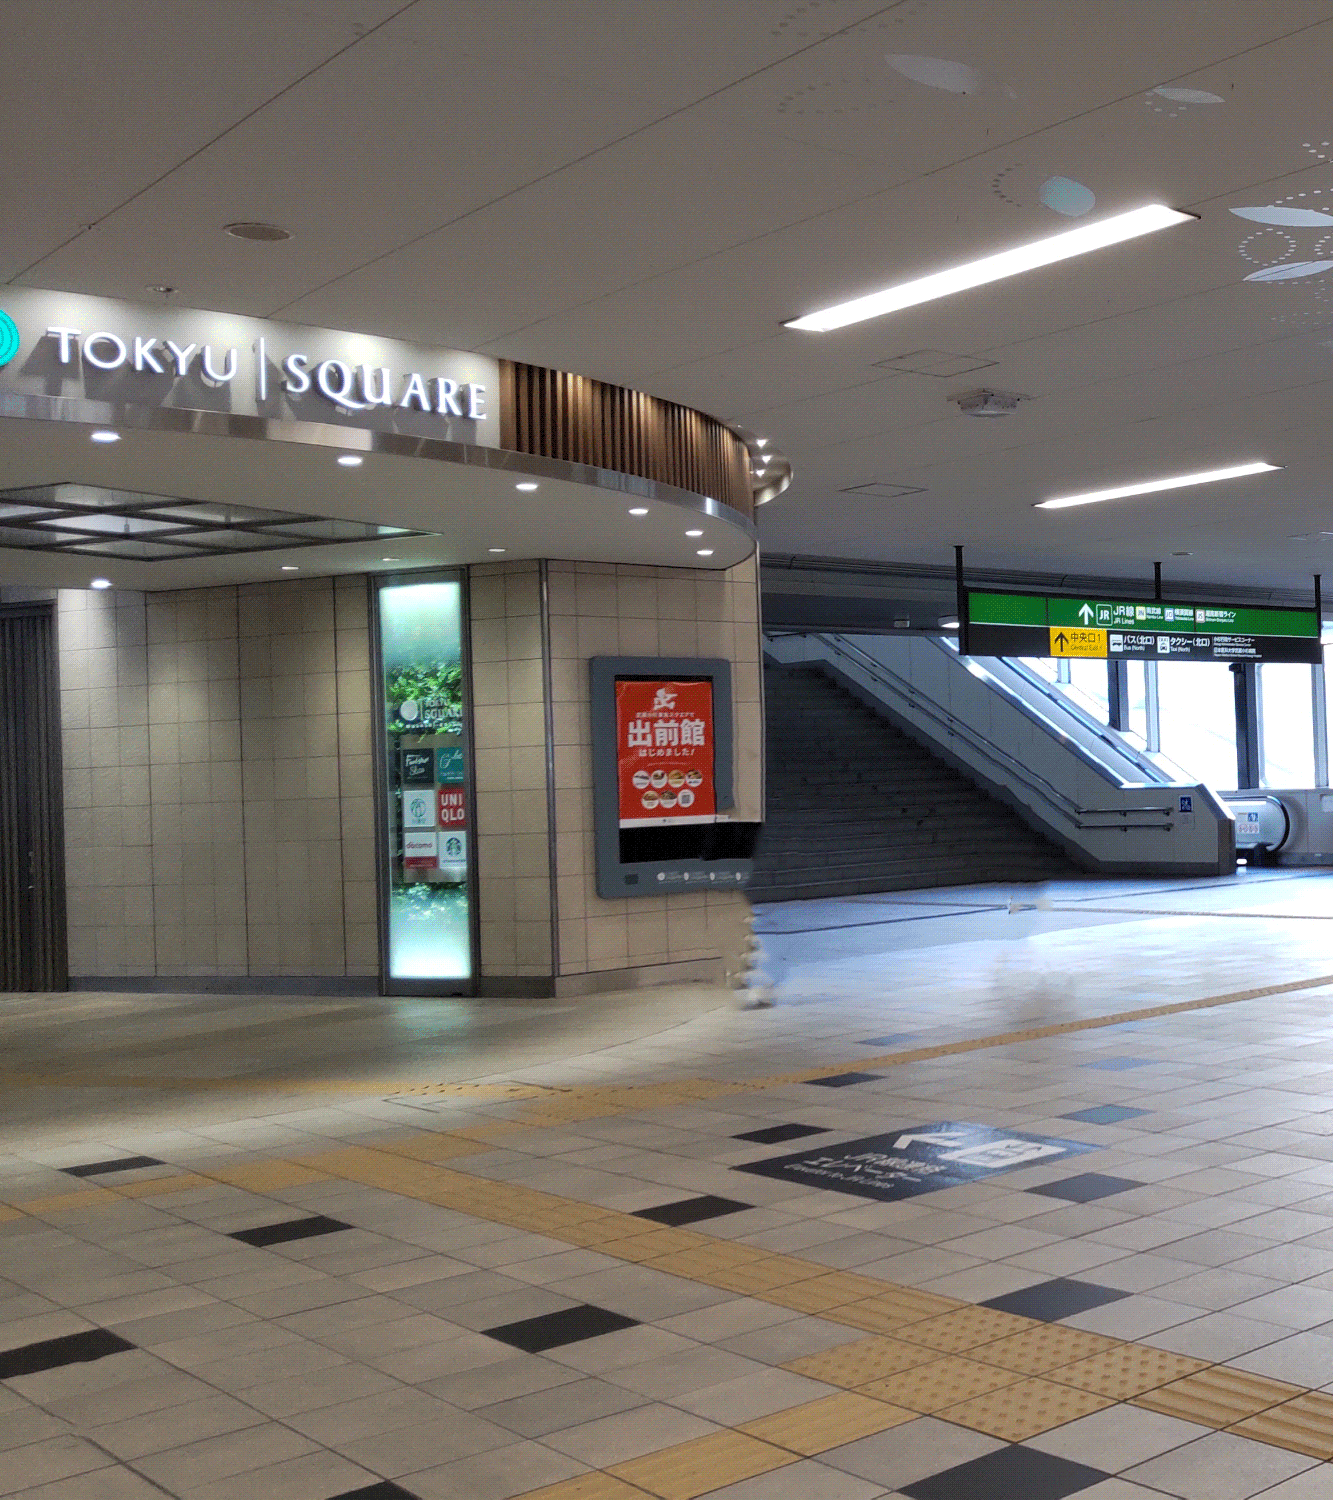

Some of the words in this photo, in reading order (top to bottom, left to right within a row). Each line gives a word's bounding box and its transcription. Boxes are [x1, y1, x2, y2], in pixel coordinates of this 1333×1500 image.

[48, 326, 238, 383] TOKYU
[284, 354, 488, 420] SQUARE
[1099, 610, 1110, 620] JR
[1113, 605, 1134, 617] JR線
[627, 718, 705, 748] 出前館
[441, 793, 463, 806] UNI
[441, 808, 465, 823] QLO
